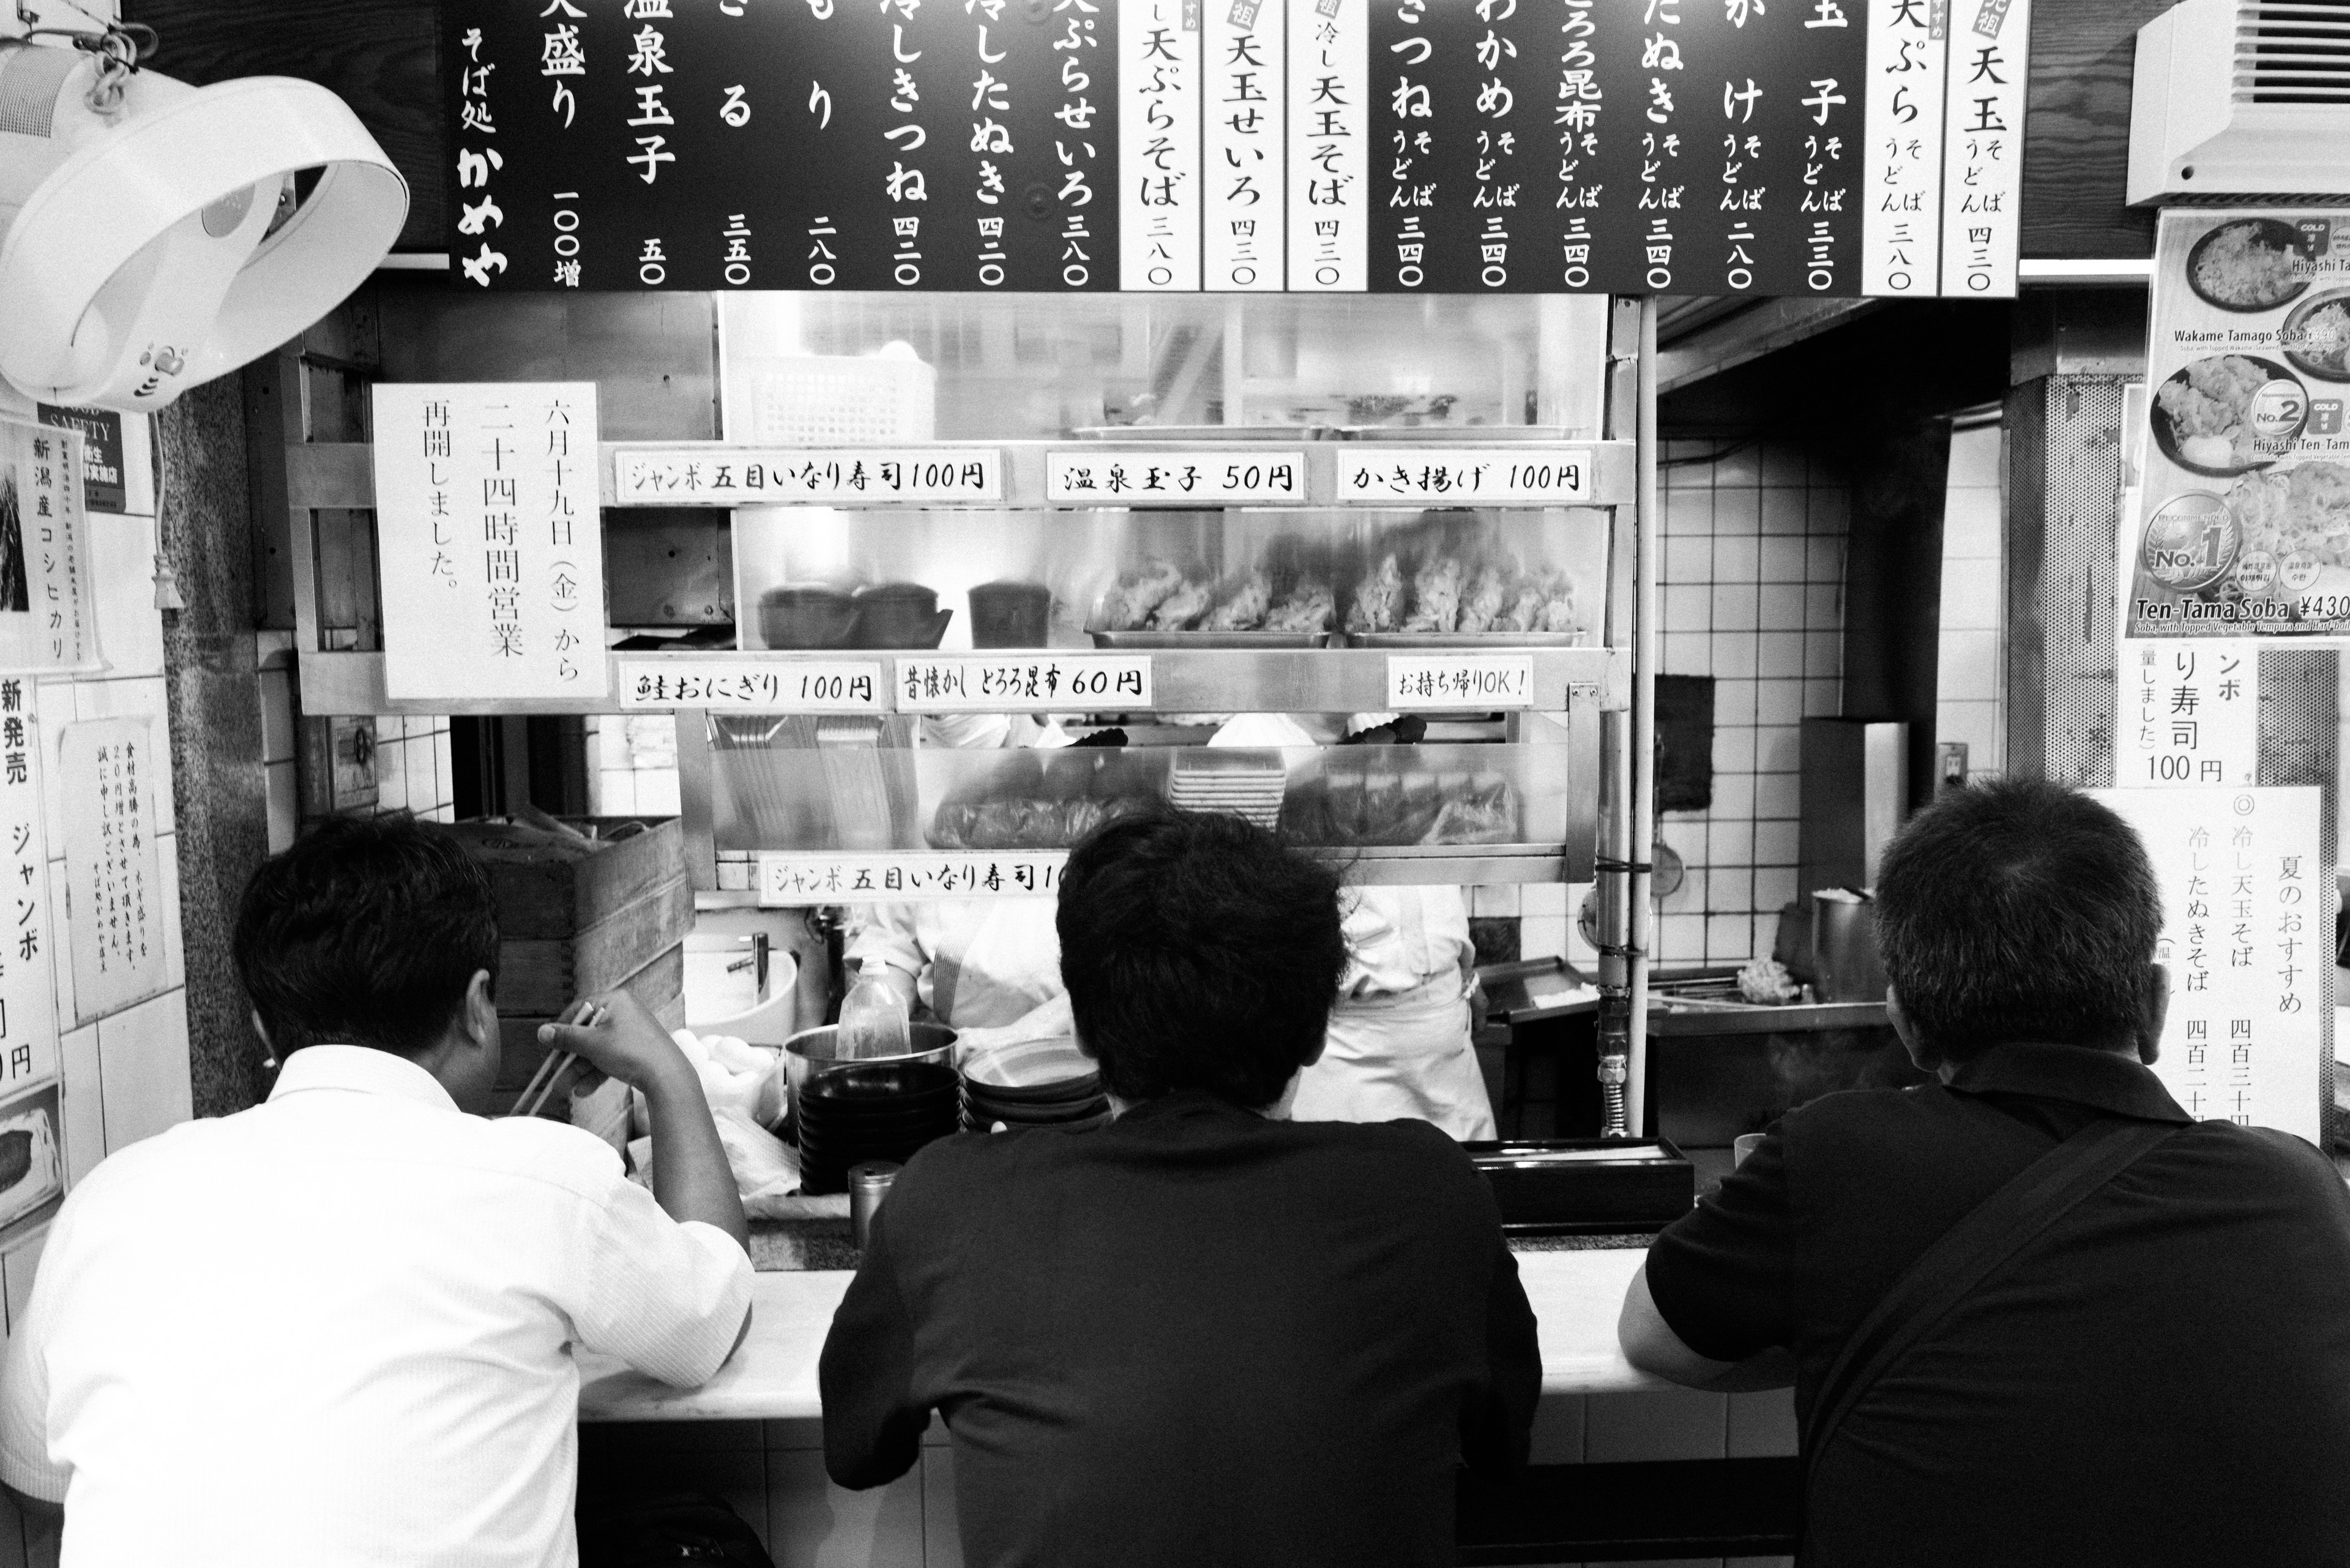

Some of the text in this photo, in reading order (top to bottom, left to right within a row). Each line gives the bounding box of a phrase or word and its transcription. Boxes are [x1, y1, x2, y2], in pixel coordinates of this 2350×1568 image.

[1556, 0, 1602, 132] ろろ昆布
[457, 28, 507, 286] そば処 かめや
[2292, 258, 2335, 275] Hiyashi
[2174, 329, 2223, 343] Wakame
[2228, 329, 2272, 345] Tamago
[2275, 329, 2303, 342] Soba
[2253, 439, 2296, 454] Hiyashi
[481, 404, 523, 657] 二十四時間営業
[2135, 622, 2158, 633] Soba,
[2160, 621, 2179, 633] with
[2180, 621, 2211, 635] Topped
[2212, 620, 2256, 634] Vegetable
[2256, 619, 2294, 633] Tempura
[2136, 599, 2234, 621] Ten-Tama
[2238, 597, 2290, 619] Soba
[2171, 652, 2199, 749] り寿司
[1, 678, 38, 961] 新発売 ジャンボ
[2278, 855, 2302, 1014] 夏のおすすめ
